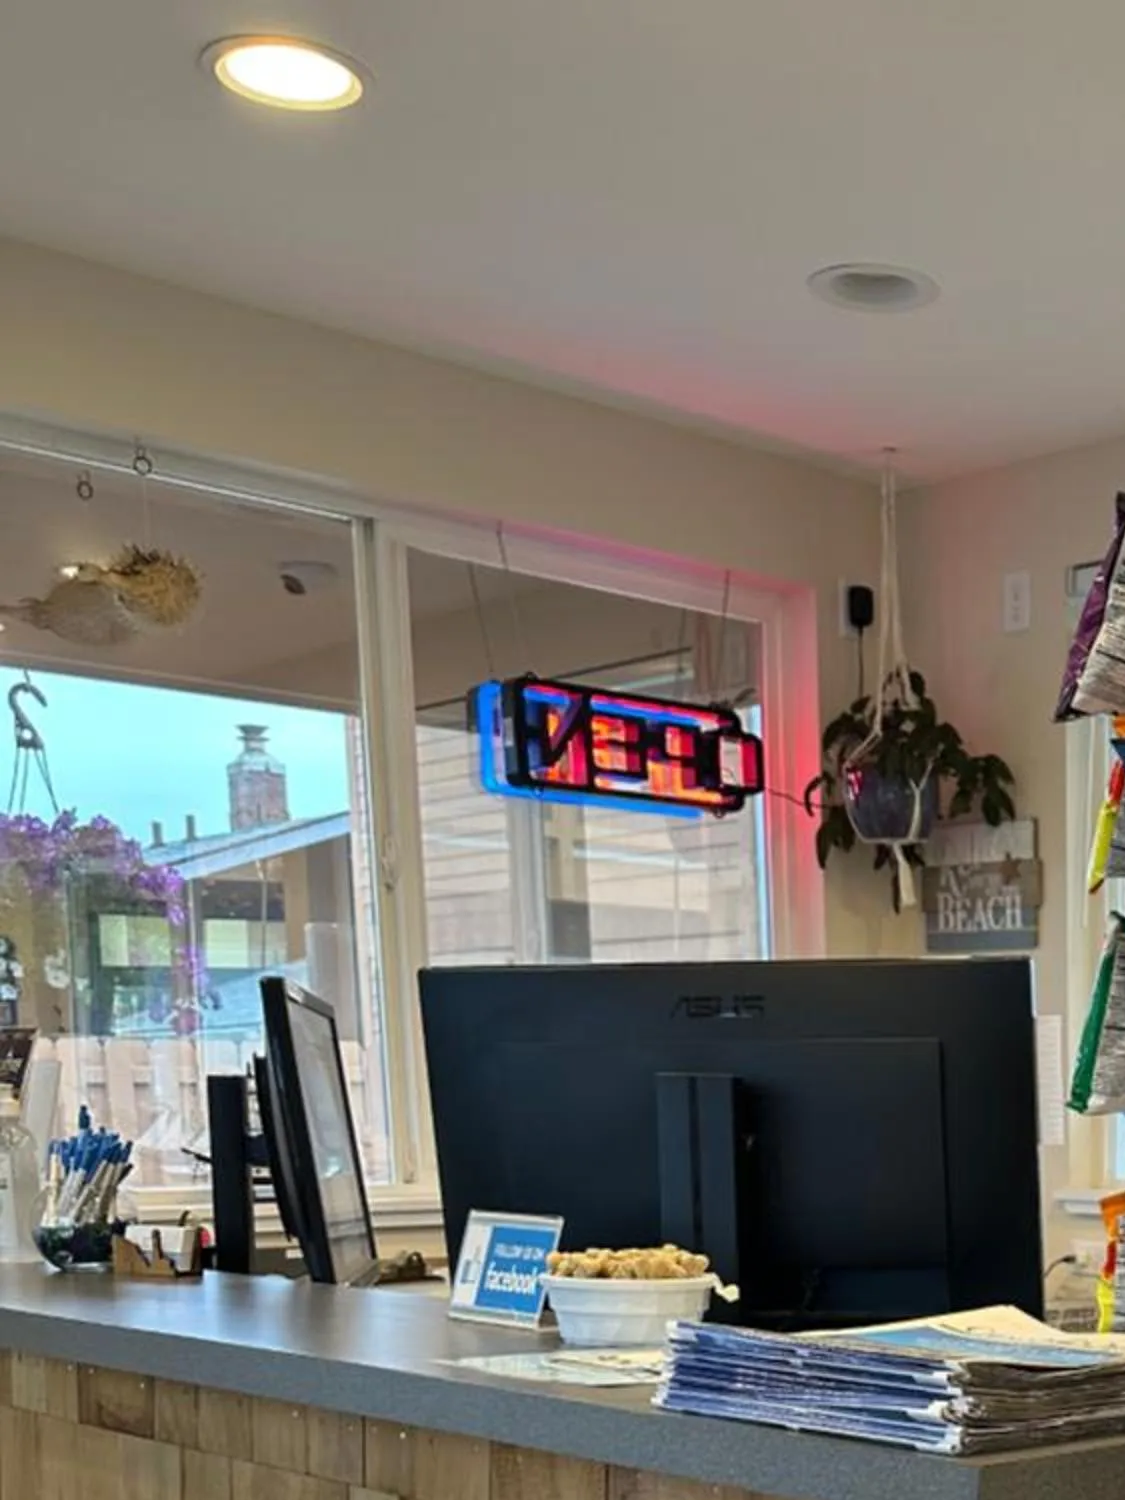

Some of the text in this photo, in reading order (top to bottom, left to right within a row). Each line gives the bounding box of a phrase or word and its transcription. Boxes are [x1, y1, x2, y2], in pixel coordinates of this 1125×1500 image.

[937, 892, 1022, 931] BEACH
[669, 995, 765, 1018] ASUS
[484, 1261, 540, 1295] facebook
